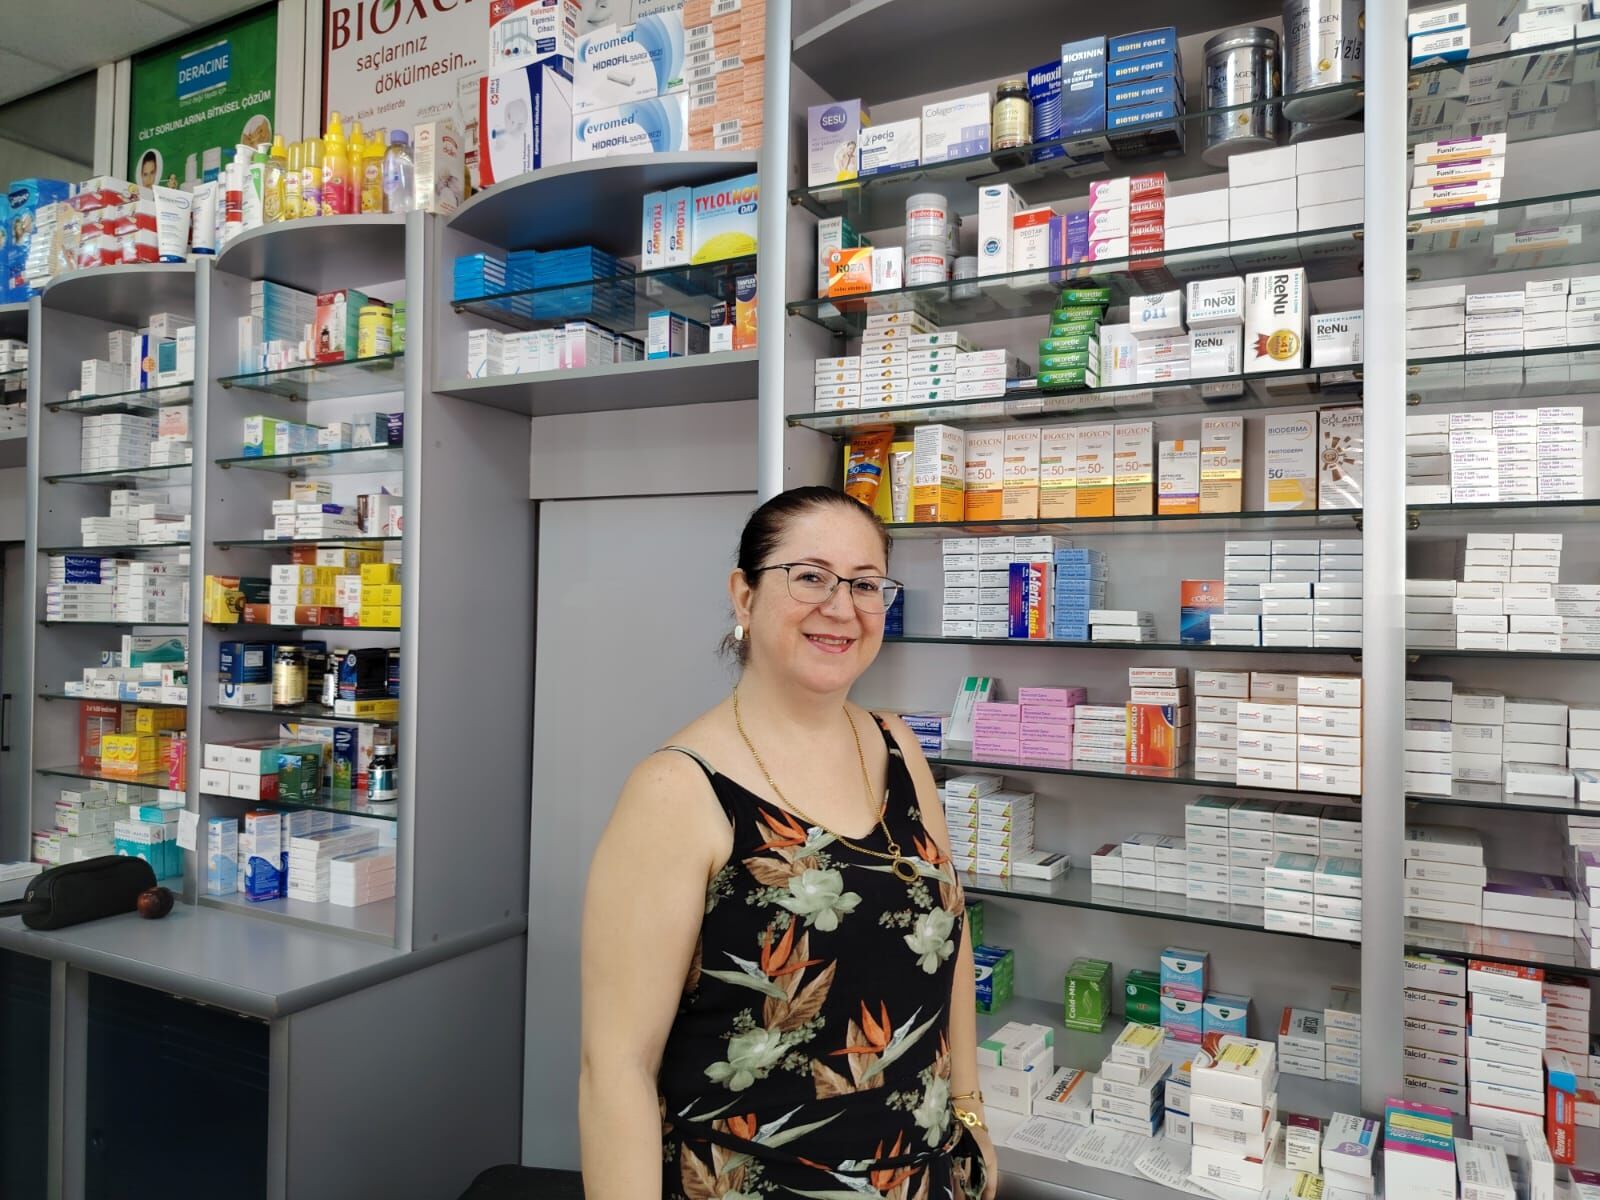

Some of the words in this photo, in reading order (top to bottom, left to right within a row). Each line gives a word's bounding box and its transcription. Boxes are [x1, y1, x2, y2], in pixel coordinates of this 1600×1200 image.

[588, 31, 635, 55] evromed
[1118, 42, 1141, 52] BIOTIN
[1143, 38, 1166, 48] FORTE
[356, 36, 427, 72] saçlarınız
[1334, 46, 1339, 59] 1
[1344, 46, 1351, 59] 2
[1354, 48, 1361, 60] 3
[178, 54, 229, 84] DERACINE
[375, 53, 477, 94] dökülmesin...
[1116, 66, 1139, 76] BIOTIN
[1141, 61, 1164, 71] FORTE
[1032, 66, 1062, 87] Minoxil
[1116, 90, 1139, 101] BIOTIN
[1141, 86, 1164, 96] FORTE
[207, 101, 241, 120] BİTKİSEL
[241, 90, 272, 110] ÇÖZÜM
[822, 114, 847, 127] SESU
[1116, 114, 1139, 125] BIOTIN
[1141, 110, 1164, 120] FORTE
[586, 114, 635, 134] evromed
[1436, 146, 1455, 154] Funif
[1436, 169, 1455, 177] Funif
[1432, 191, 1451, 199] Funif
[742, 204, 754, 213] DAY
[1075, 290, 1103, 298] nicorette
[1273, 274, 1289, 316] ReNu
[1204, 294, 1236, 308] ReNu
[1062, 324, 1087, 332] nicorette
[1317, 324, 1349, 335] ReNu
[1052, 338, 1079, 347] nicorette
[1194, 338, 1223, 349] ReNu
[1052, 355, 1080, 363] nicorette
[1204, 421, 1241, 430] BIOXCIN
[1268, 426, 1308, 435] BIODERMA
[1006, 432, 1039, 441] BIOXCIN
[1044, 432, 1075, 441] BIOXCIN
[1078, 430, 1111, 439] BIOXCIN
[1116, 427, 1150, 436] BIOXCIN
[968, 438, 1002, 448] BIOXCIN
[1404, 961, 1427, 971] Talcid
[1404, 991, 1427, 1001] Talcid
[1404, 1020, 1426, 1030] Talcid
[1404, 1049, 1427, 1060] Talcid
[1404, 1078, 1427, 1089] Talcid
[1390, 1132, 1450, 1148] GAVISCON
[1555, 1128, 1566, 1158] Rennie
